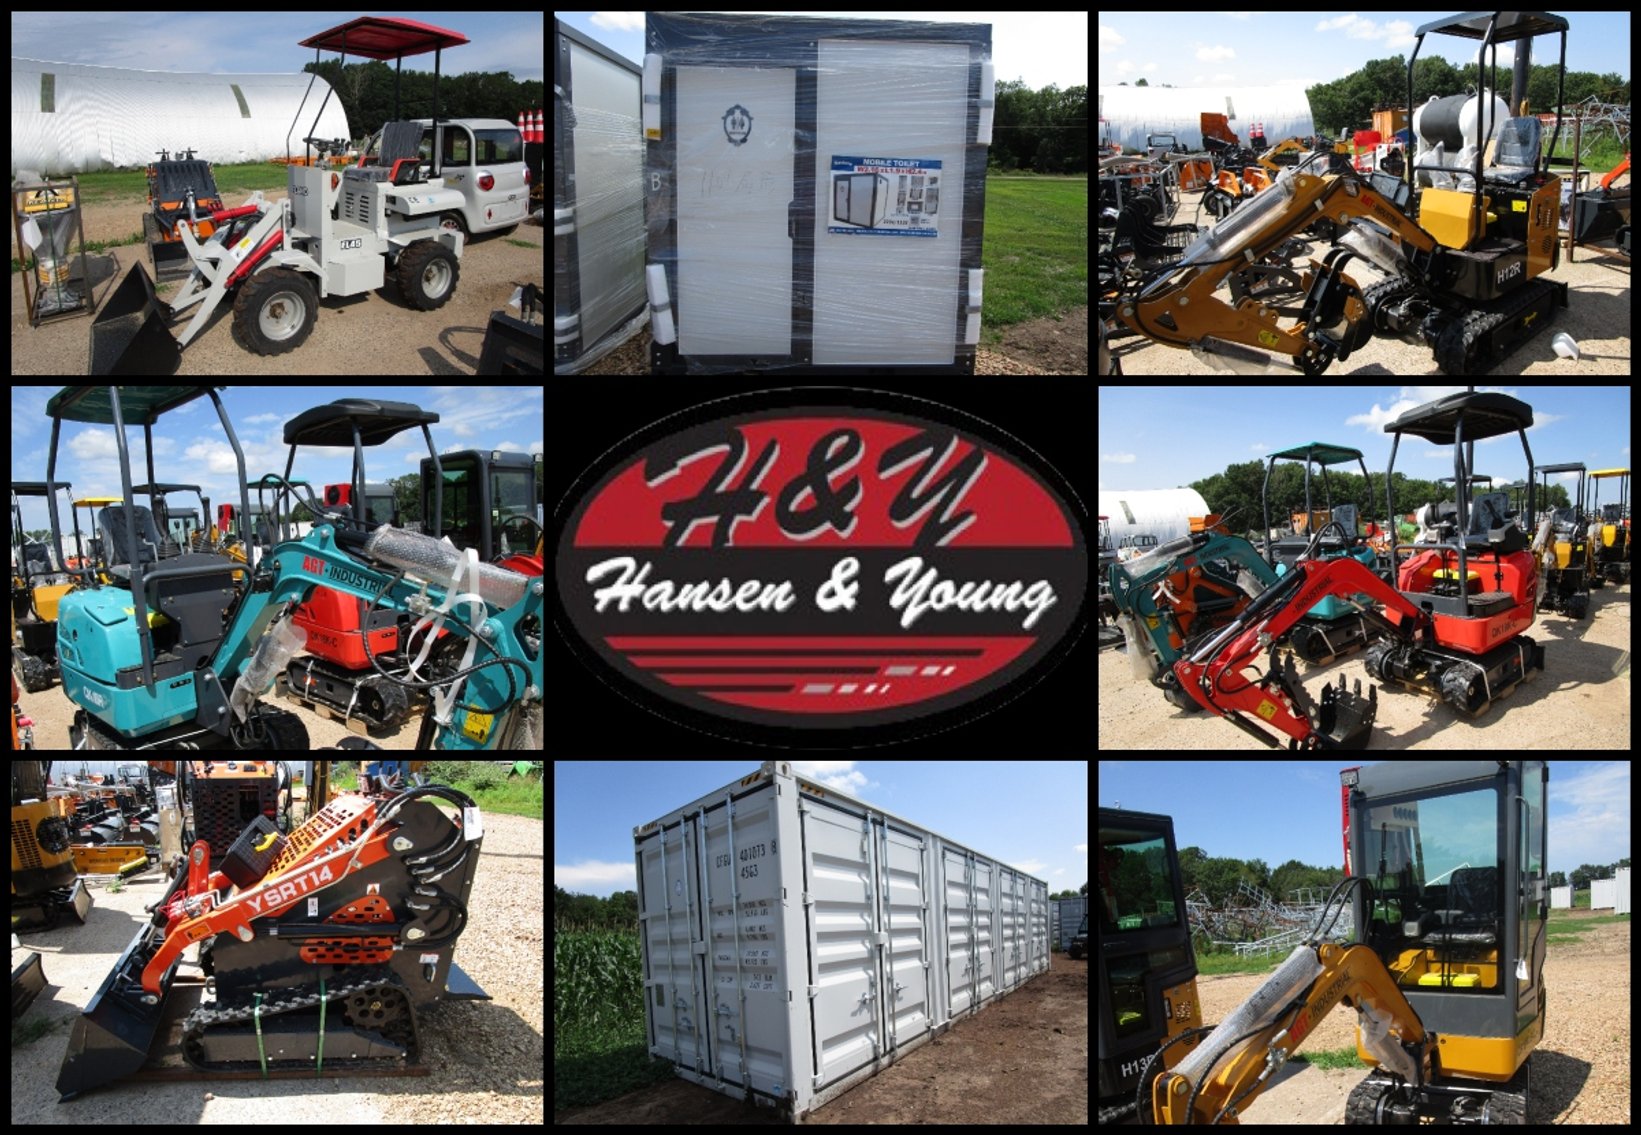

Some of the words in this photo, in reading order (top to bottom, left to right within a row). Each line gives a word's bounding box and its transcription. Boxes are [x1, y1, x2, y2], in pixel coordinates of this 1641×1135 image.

[863, 158, 892, 167] MOBILE
[894, 160, 920, 168] TOILET
[651, 172, 661, 191] B
[1497, 262, 1521, 284] H12R
[302, 555, 325, 575] AGT
[246, 864, 334, 913] YSRT14
[1311, 967, 1351, 1018] INDUSTRIAL
